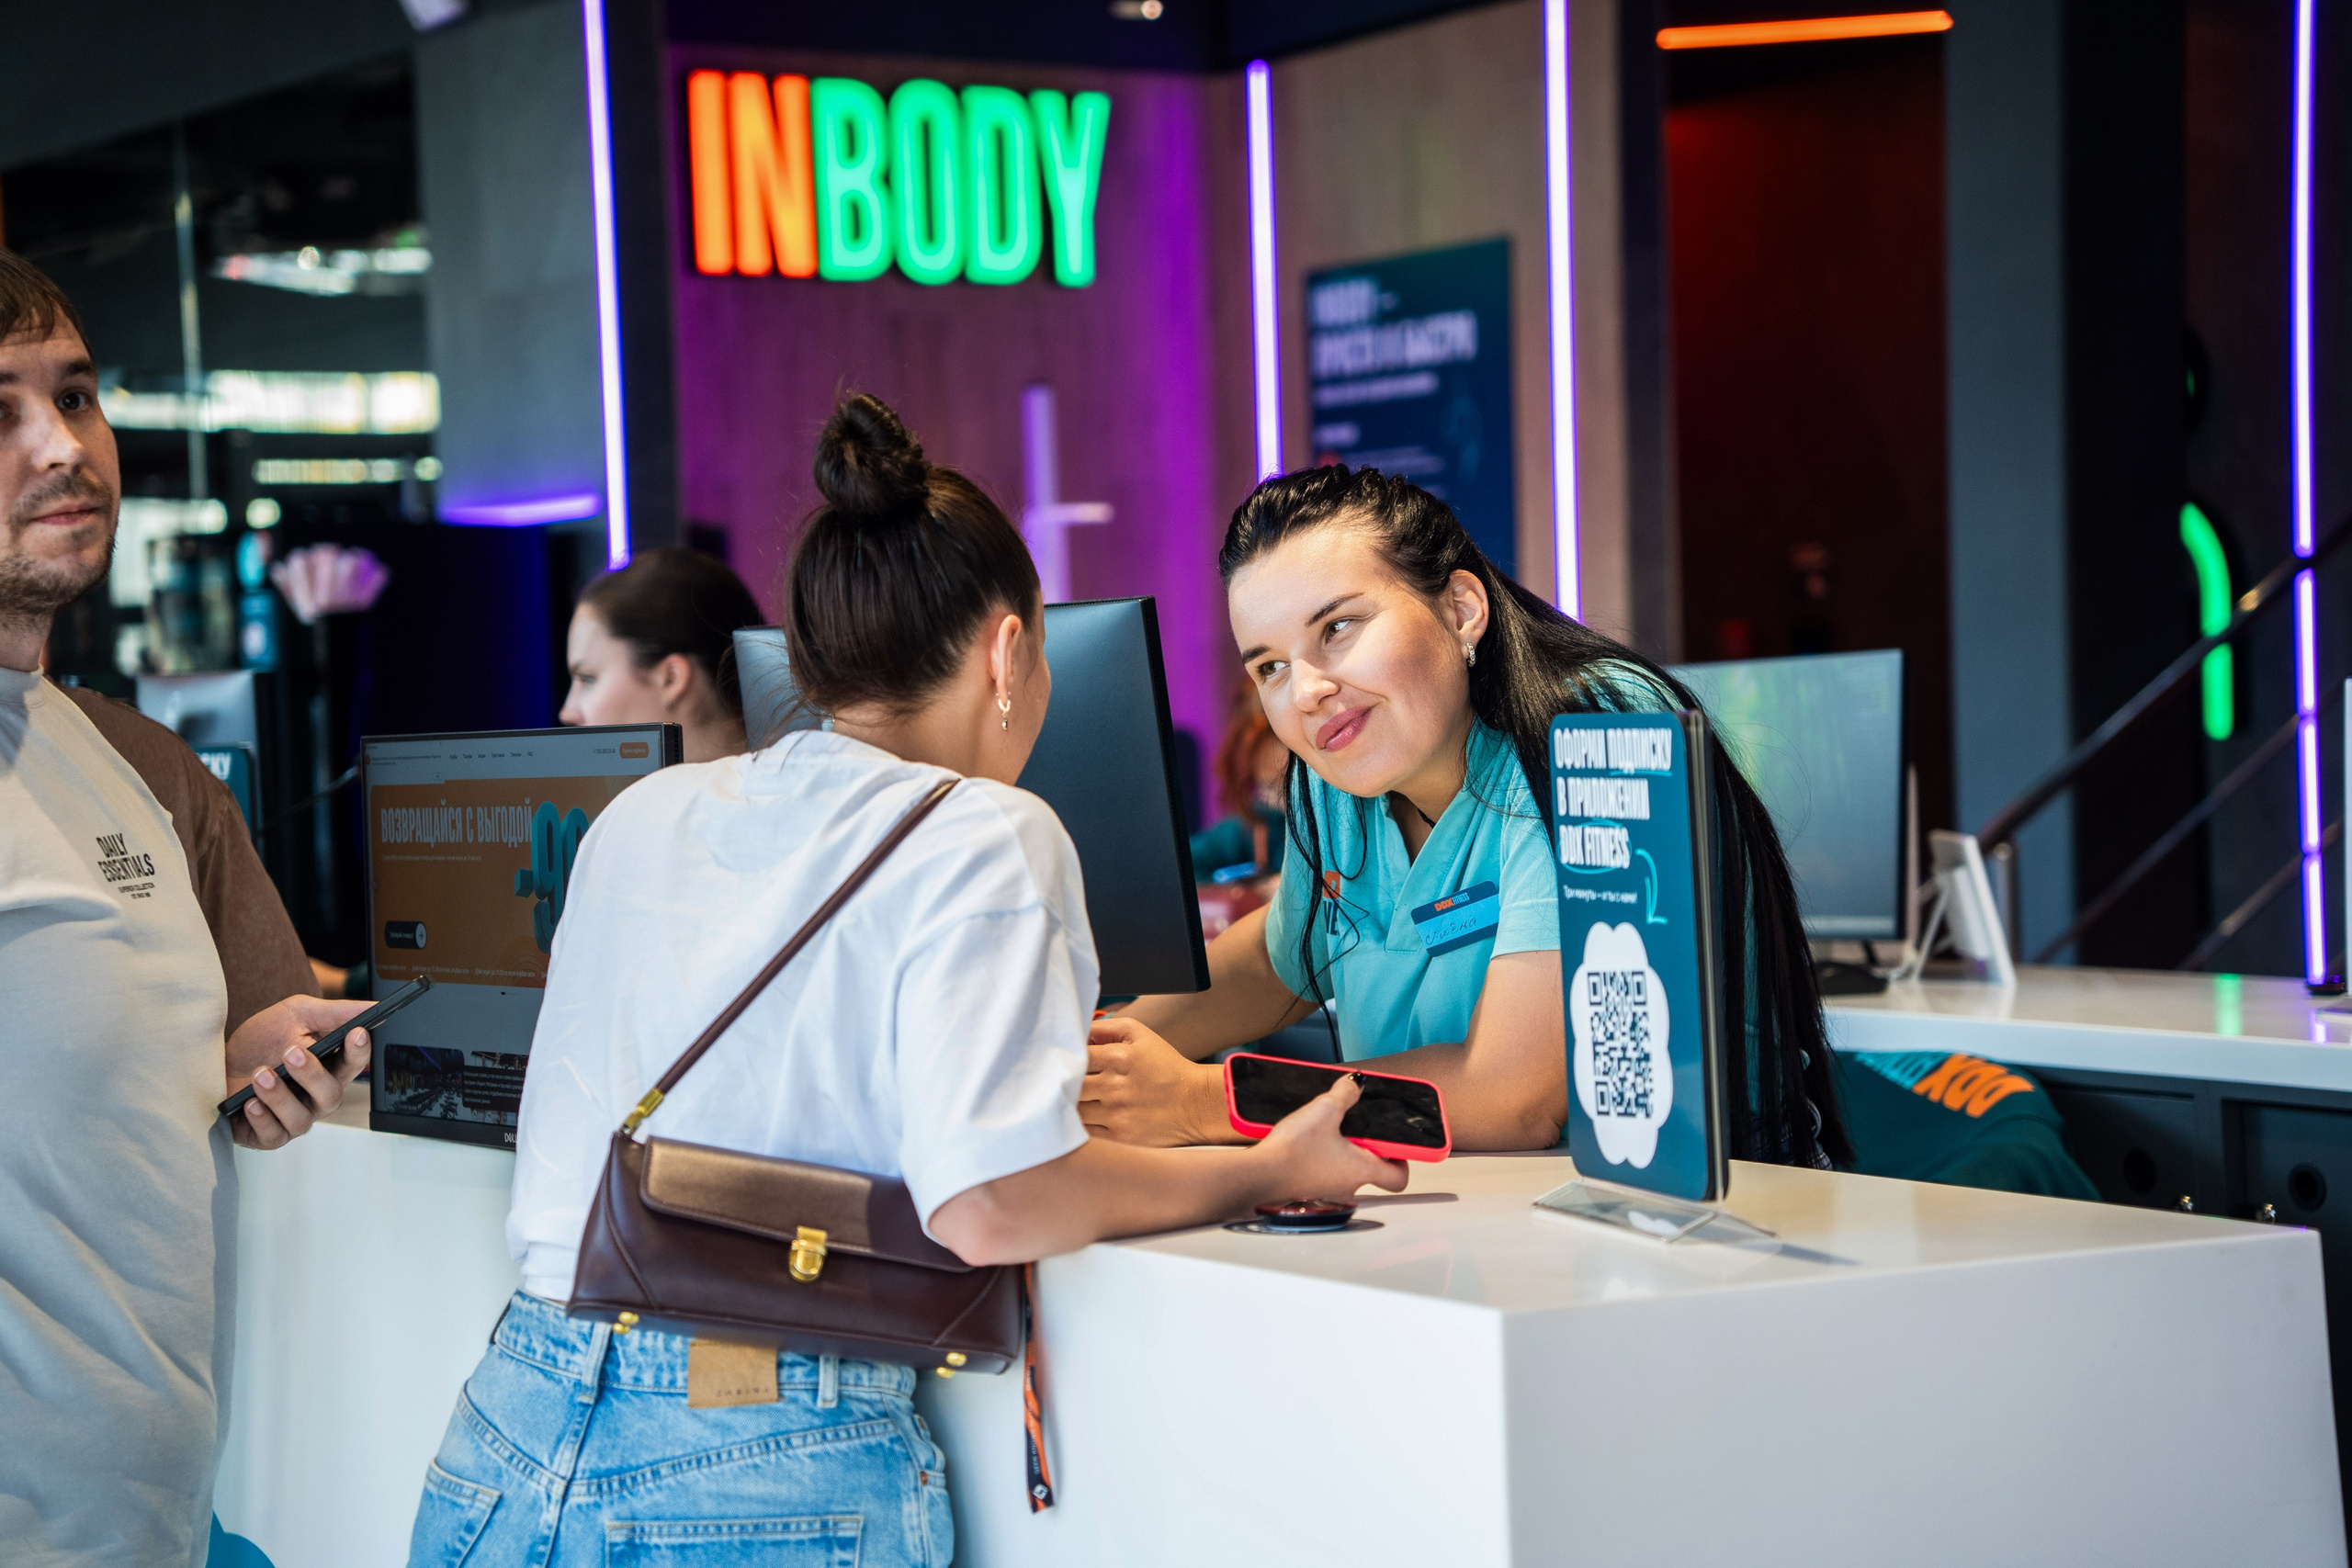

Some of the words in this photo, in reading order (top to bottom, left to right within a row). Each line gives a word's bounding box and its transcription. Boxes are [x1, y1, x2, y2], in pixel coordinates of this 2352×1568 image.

[687, 68, 1111, 288] INBODY
[1554, 727, 1606, 770] ОФОРМИ
[1606, 727, 1672, 775] ПОДПИСКУ
[1556, 776, 1567, 817] В
[1567, 777, 1650, 820] ПРИЛОЖЕНИИ
[96, 832, 129, 858] DAILY
[380, 799, 463, 848] ВОЗВРАЩАЙСЯ
[466, 806, 473, 843] С
[477, 797, 532, 848] ВЫГОДОЙ
[96, 853, 155, 882] ESSENTIALS
[1559, 824, 1585, 865] DDX
[1585, 826, 1631, 870] FITNESS
